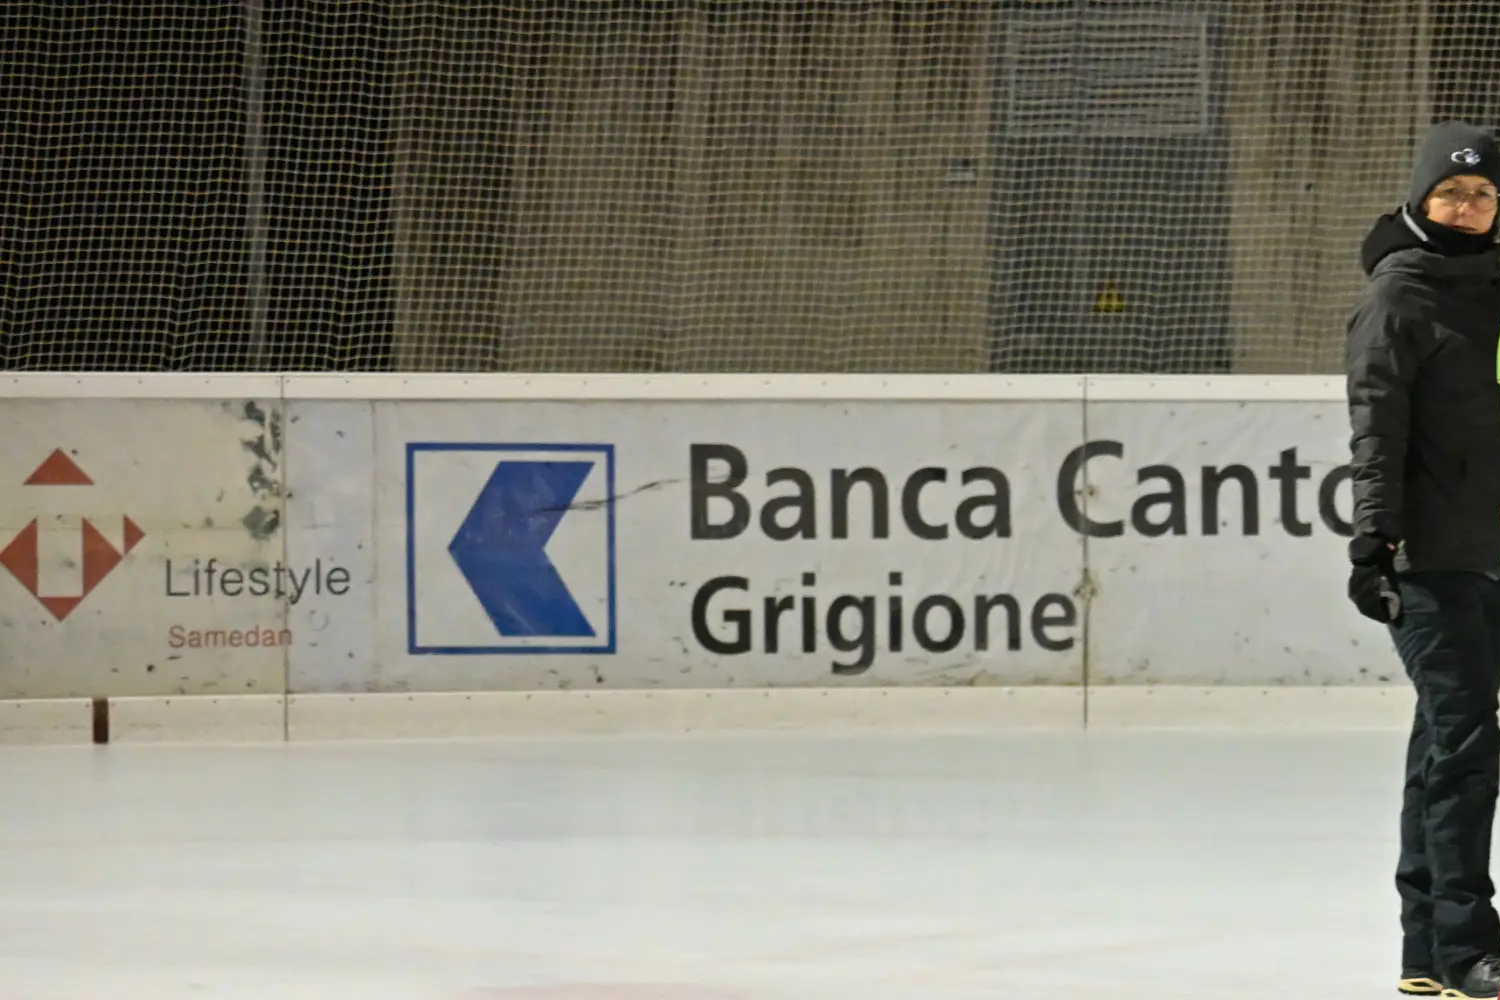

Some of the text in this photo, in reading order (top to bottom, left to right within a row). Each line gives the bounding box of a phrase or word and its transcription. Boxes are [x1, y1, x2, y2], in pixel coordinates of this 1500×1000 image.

[689, 443, 1012, 542] Banca
[165, 557, 351, 605] Lifestyle
[167, 624, 293, 649] Samedan
[690, 572, 1077, 675] Grigione
